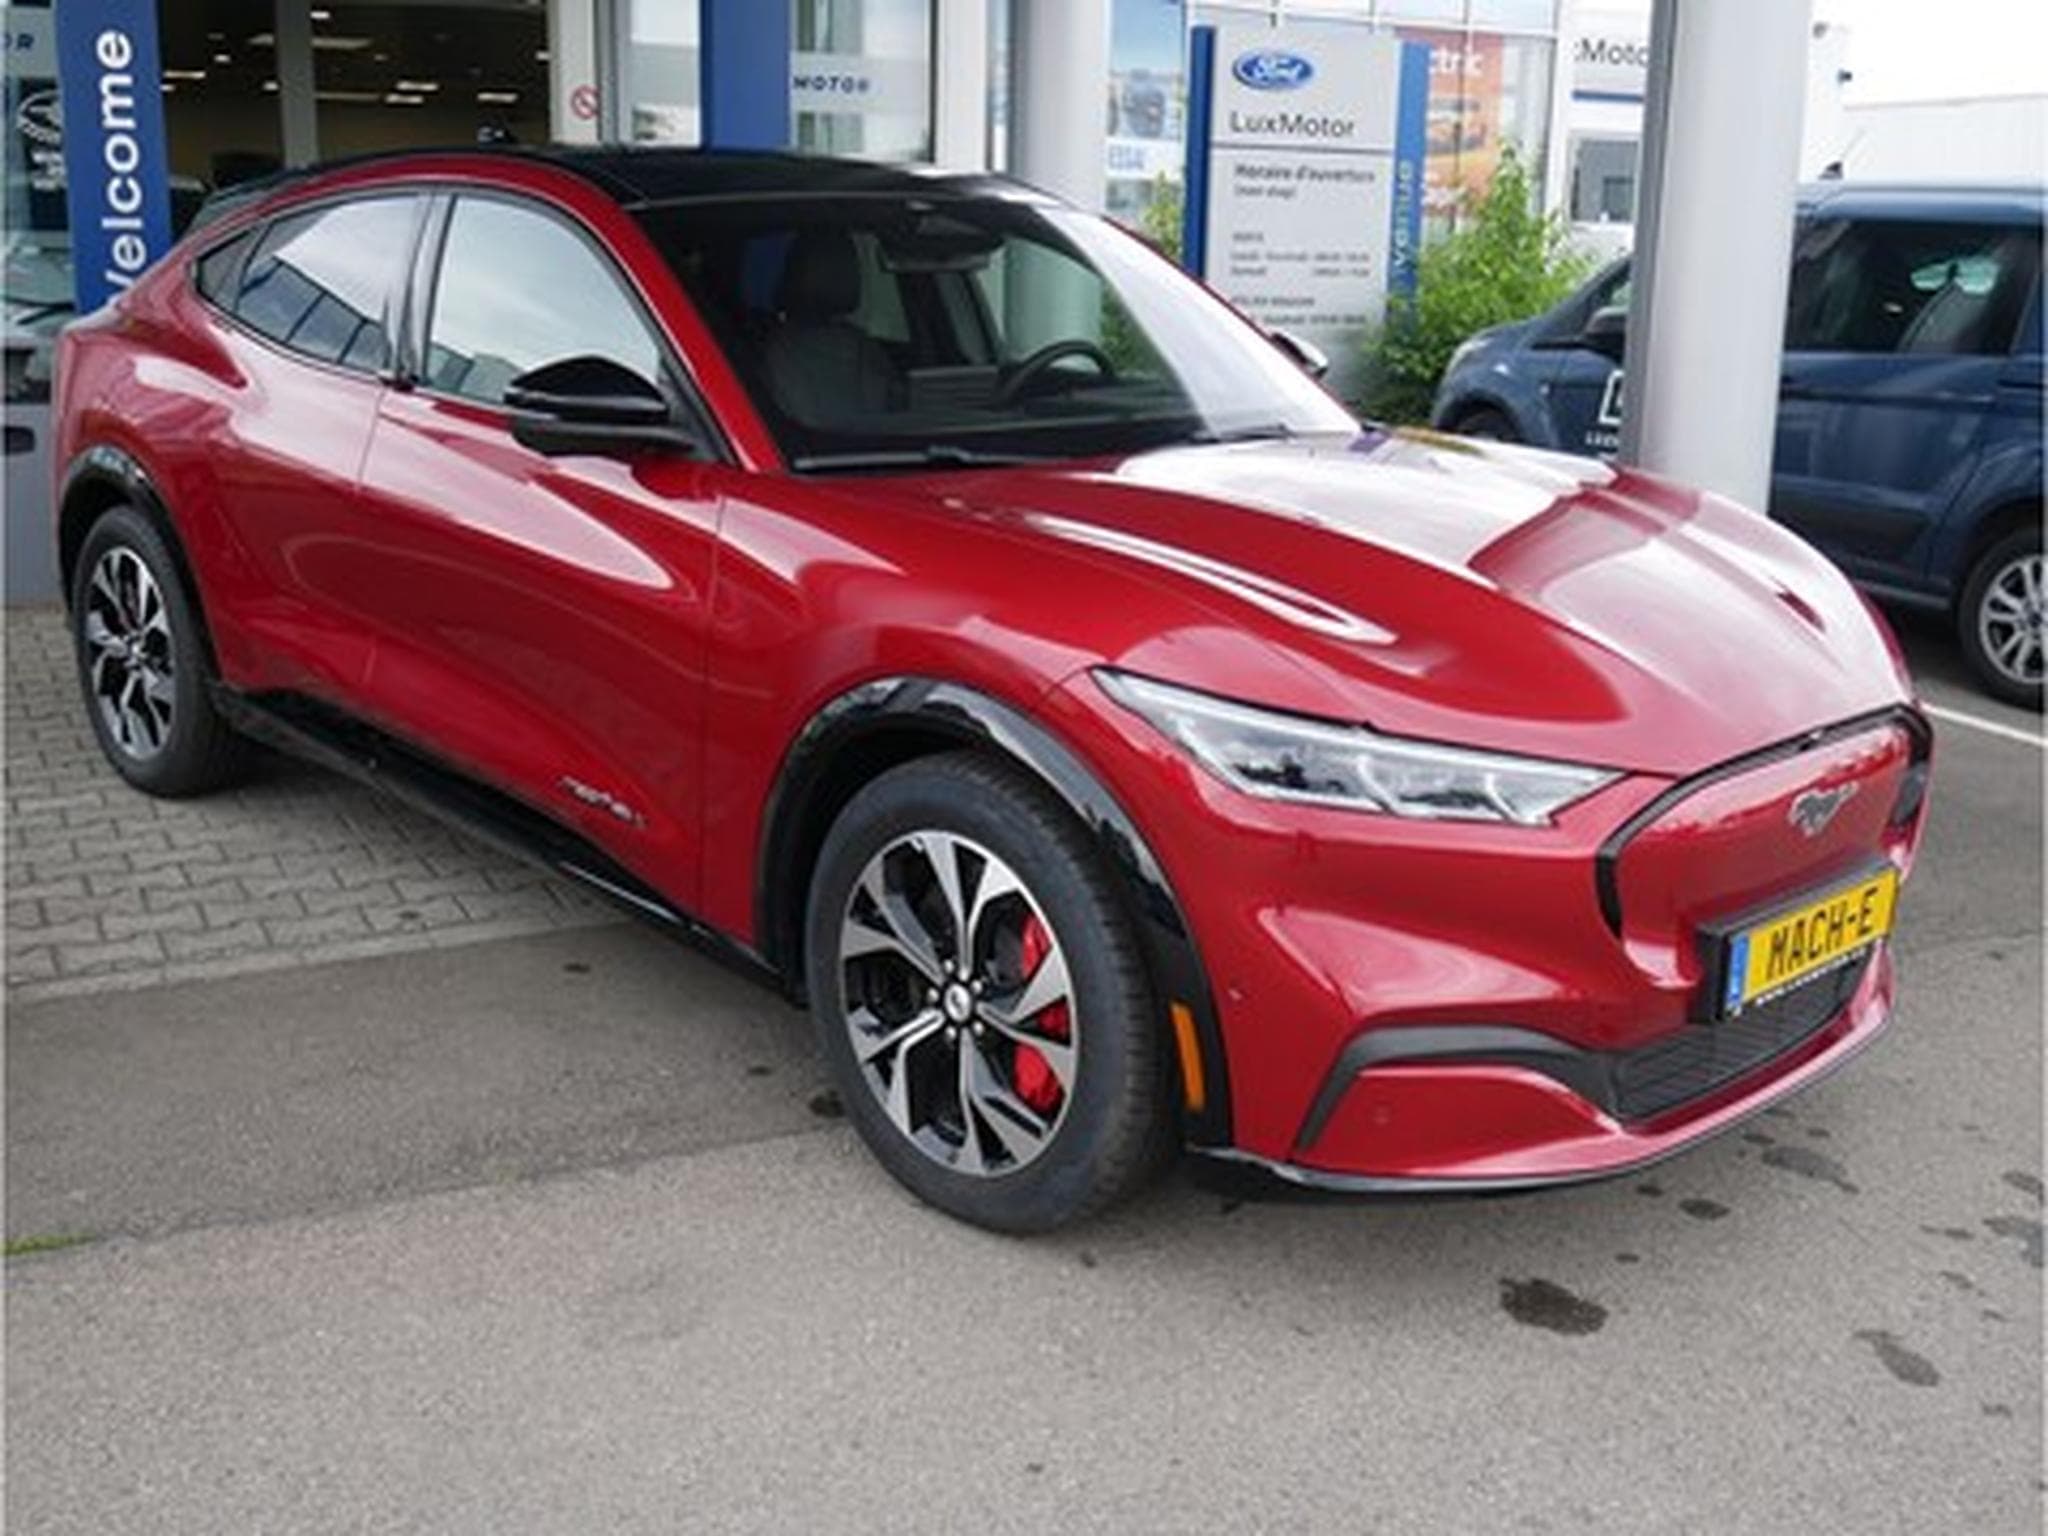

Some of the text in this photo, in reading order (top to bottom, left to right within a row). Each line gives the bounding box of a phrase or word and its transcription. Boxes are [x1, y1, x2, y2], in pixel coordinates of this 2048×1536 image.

[792, 75, 870, 94] MOTOR
[1230, 111, 1354, 137] LuxMotor
[1766, 886, 1878, 981] MACH-E
